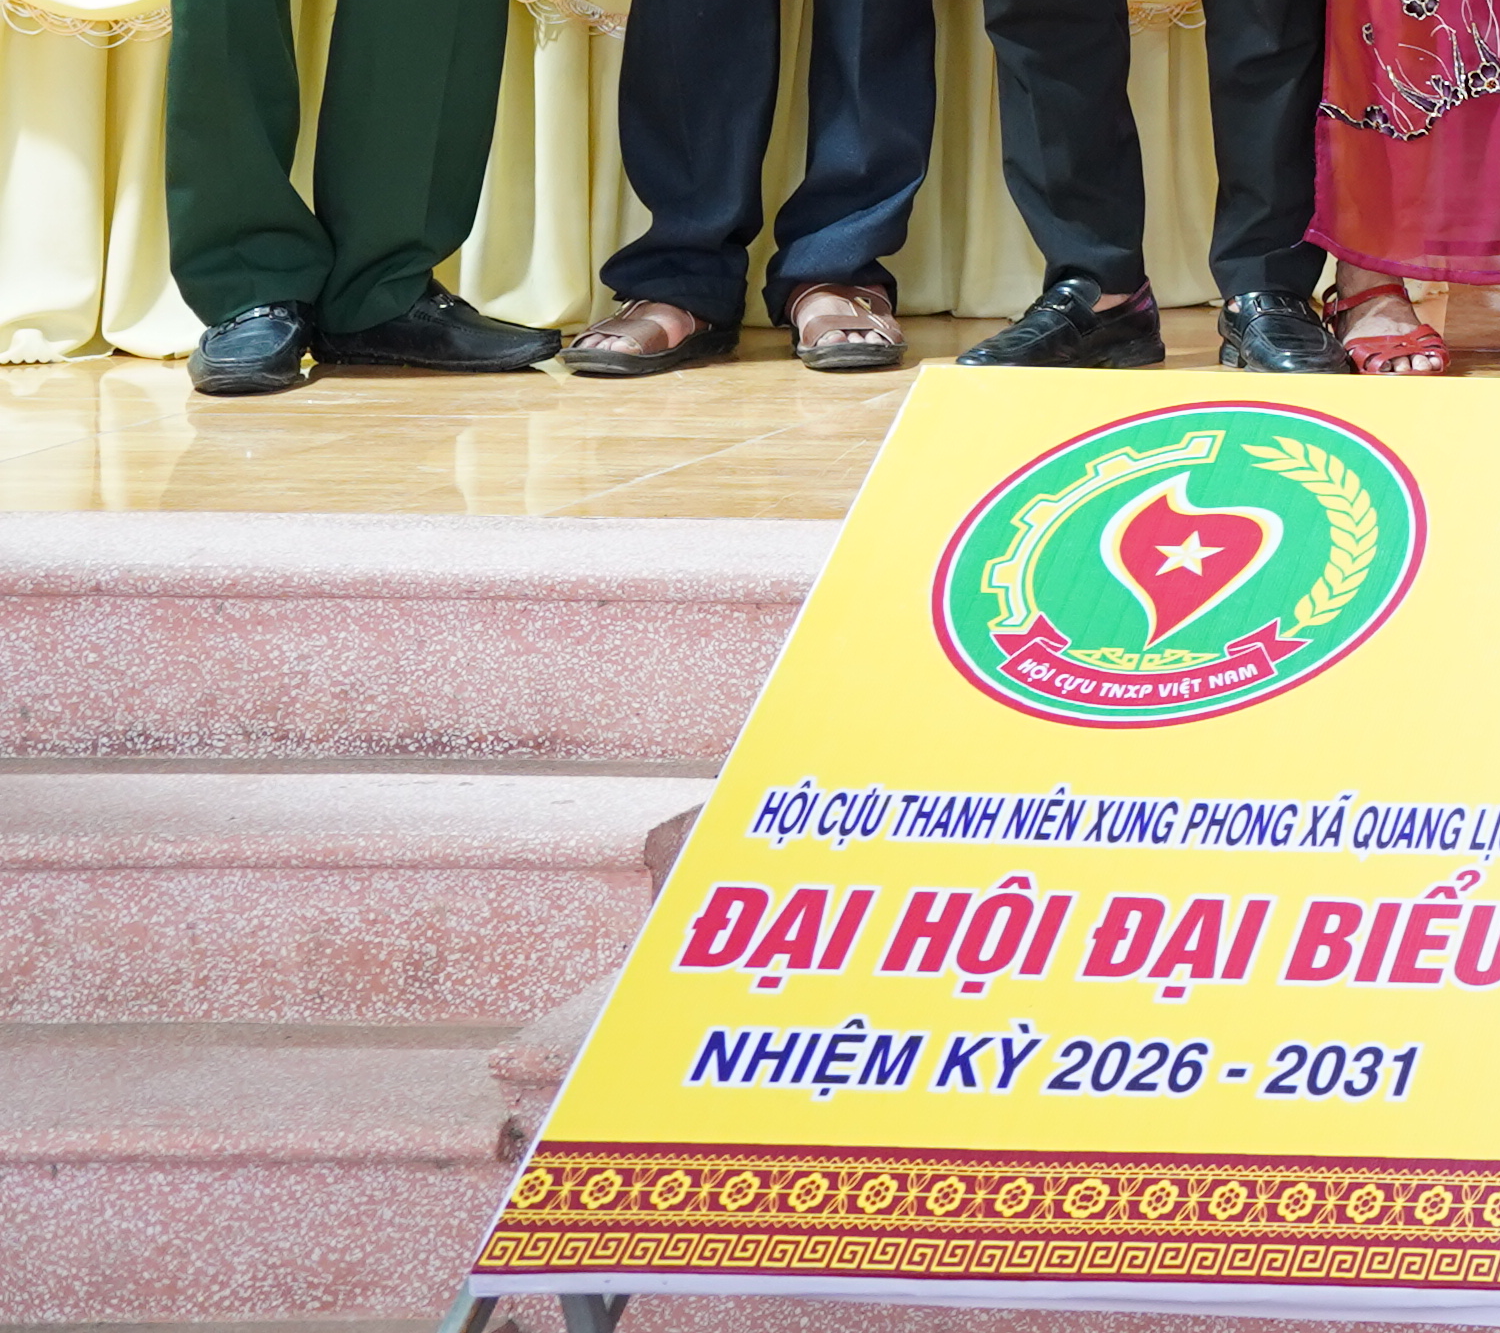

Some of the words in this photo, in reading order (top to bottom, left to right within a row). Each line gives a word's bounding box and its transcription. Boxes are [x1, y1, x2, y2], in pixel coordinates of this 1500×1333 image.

[1017, 658, 1056, 683] HỘI
[1055, 672, 1096, 695] CỰU
[1100, 681, 1152, 699] TNXP
[1158, 677, 1201, 699] VIỆT
[1208, 662, 1259, 689] NAM
[754, 781, 819, 850] HỘI
[818, 787, 891, 850] CỰU
[894, 796, 1003, 836] THANH
[1005, 787, 1085, 841] NIÊN
[1085, 801, 1177, 843] XUNG
[1182, 804, 1297, 846] PHONG
[1300, 792, 1347, 848] XÃ
[1354, 807, 1464, 852] QUANG
[680, 888, 873, 988] ĐẠI
[882, 877, 1070, 993] HỘI
[1083, 898, 1269, 997] ĐẠI
[692, 1020, 923, 1106] NHIỆM
[937, 1024, 1040, 1087] KỲ
[1048, 1041, 1207, 1092] 2026
[1227, 1069, 1245, 1077] -
[1265, 1046, 1416, 1096] 2031
